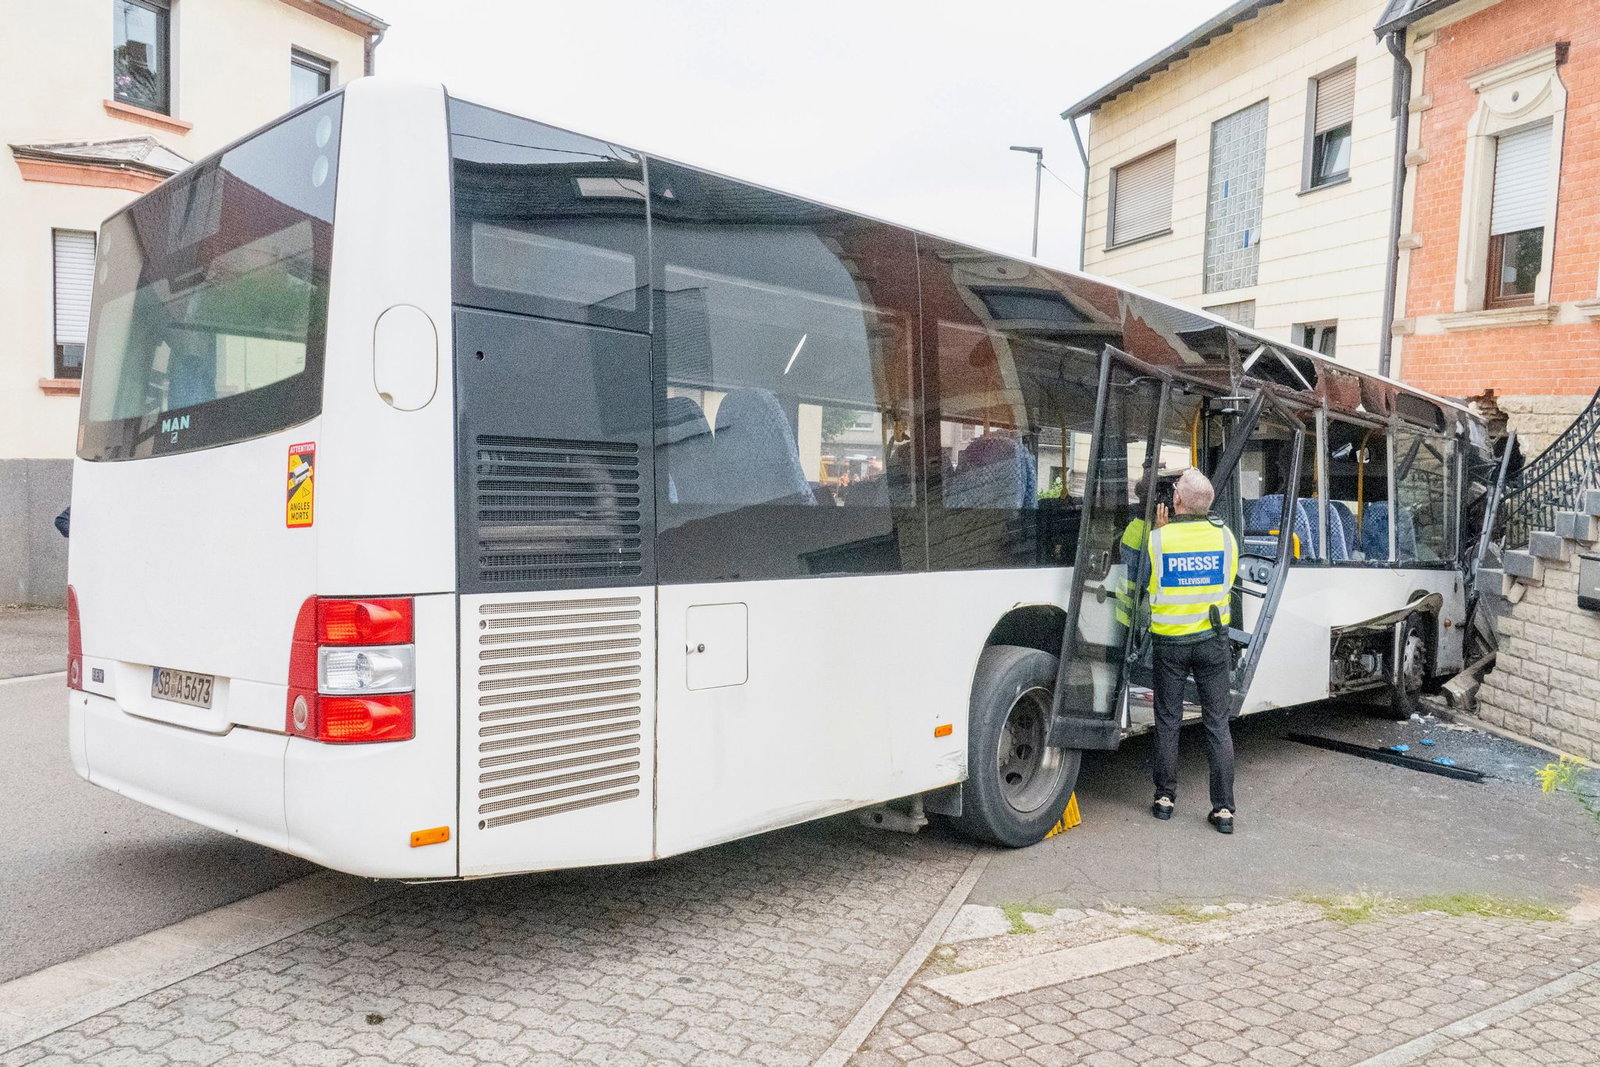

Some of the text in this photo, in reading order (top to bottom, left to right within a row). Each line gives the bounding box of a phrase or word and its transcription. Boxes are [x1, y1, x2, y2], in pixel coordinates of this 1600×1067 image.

[162, 414, 190, 433] MAN
[290, 501, 310, 511] ANGLES
[291, 511, 309, 520] MORTS
[1168, 555, 1219, 572] PRESSE
[1178, 577, 1211, 585] TELEVISION
